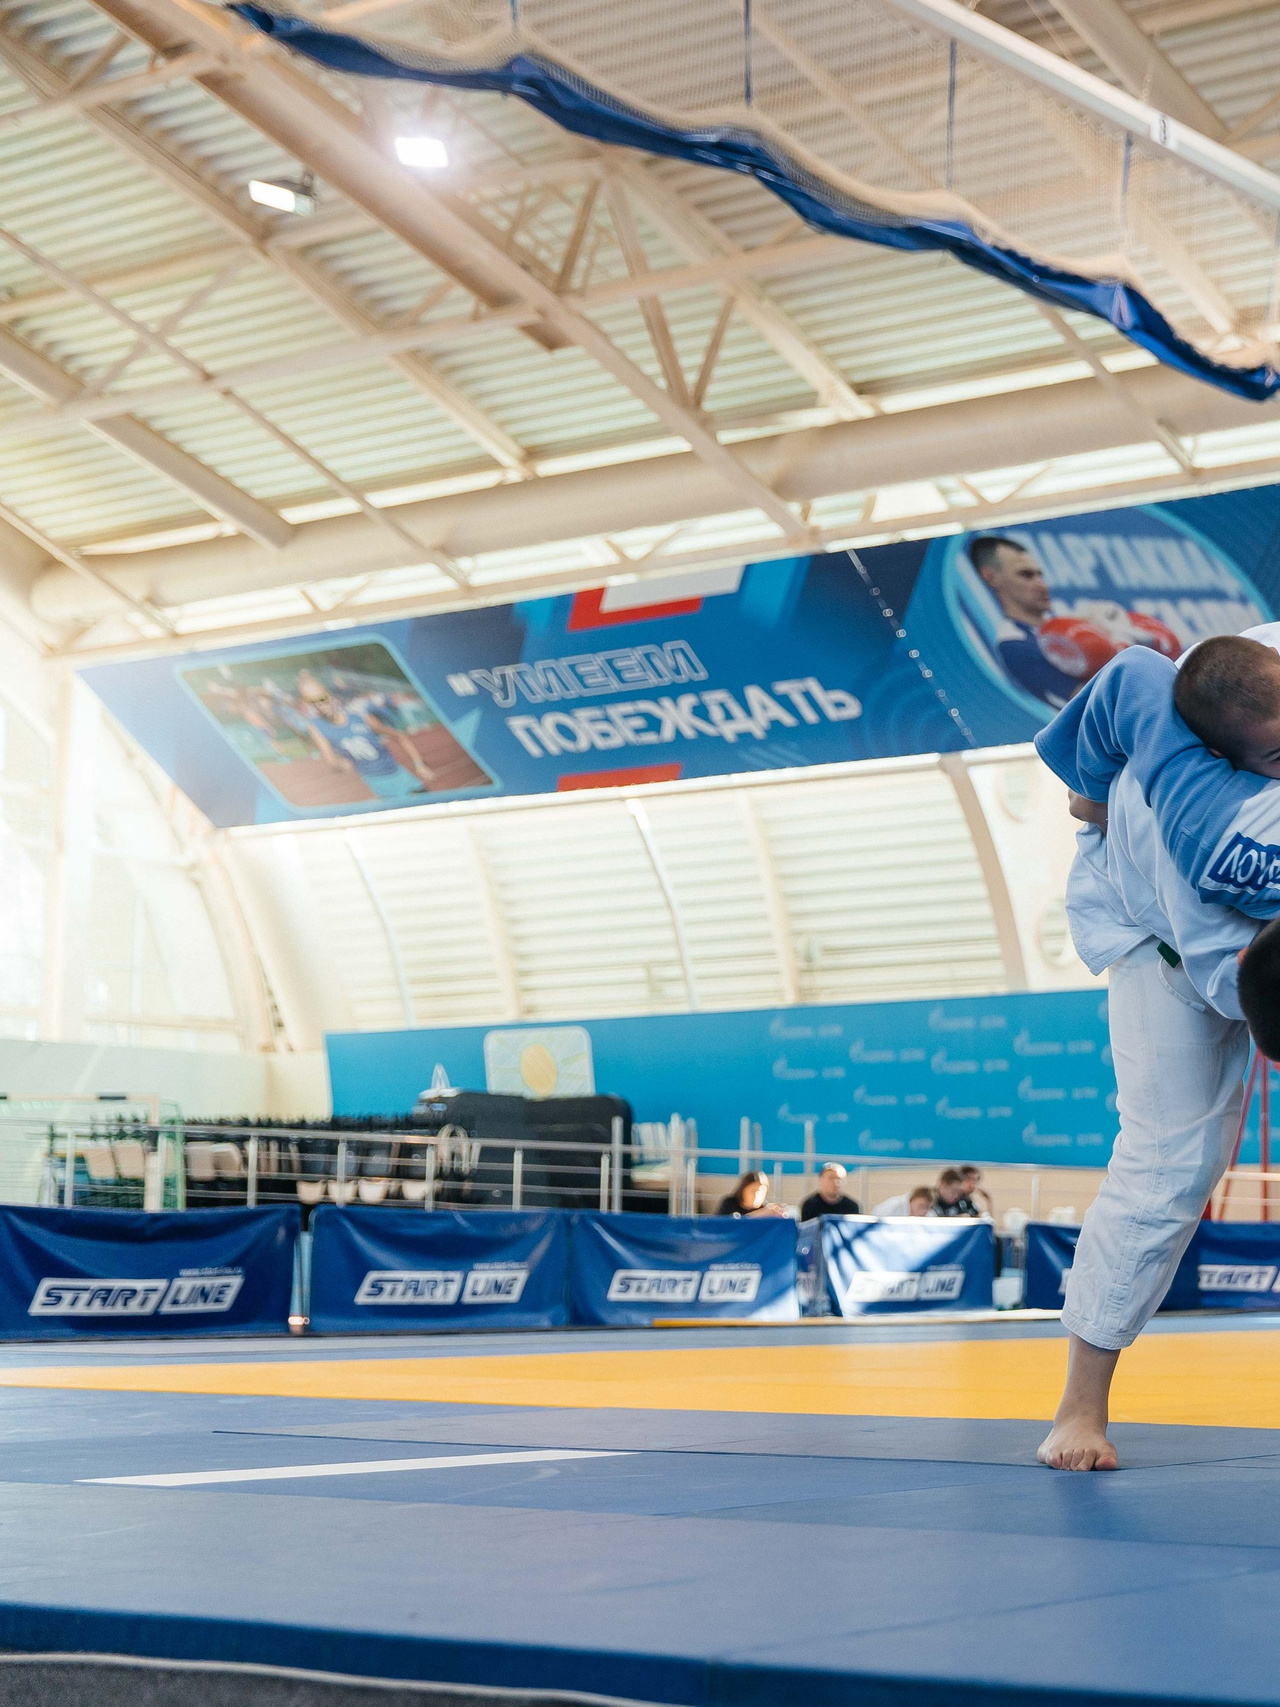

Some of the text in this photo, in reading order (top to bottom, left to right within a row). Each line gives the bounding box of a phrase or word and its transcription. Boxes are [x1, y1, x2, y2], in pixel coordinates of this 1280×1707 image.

[505, 676, 863, 757] ПОБЕЖДАТЬ
[363, 1275, 519, 1298] START LINE
[615, 1275, 753, 1296] START LINE
[1199, 1269, 1269, 1286] TART
[38, 1281, 234, 1309] START LINE
